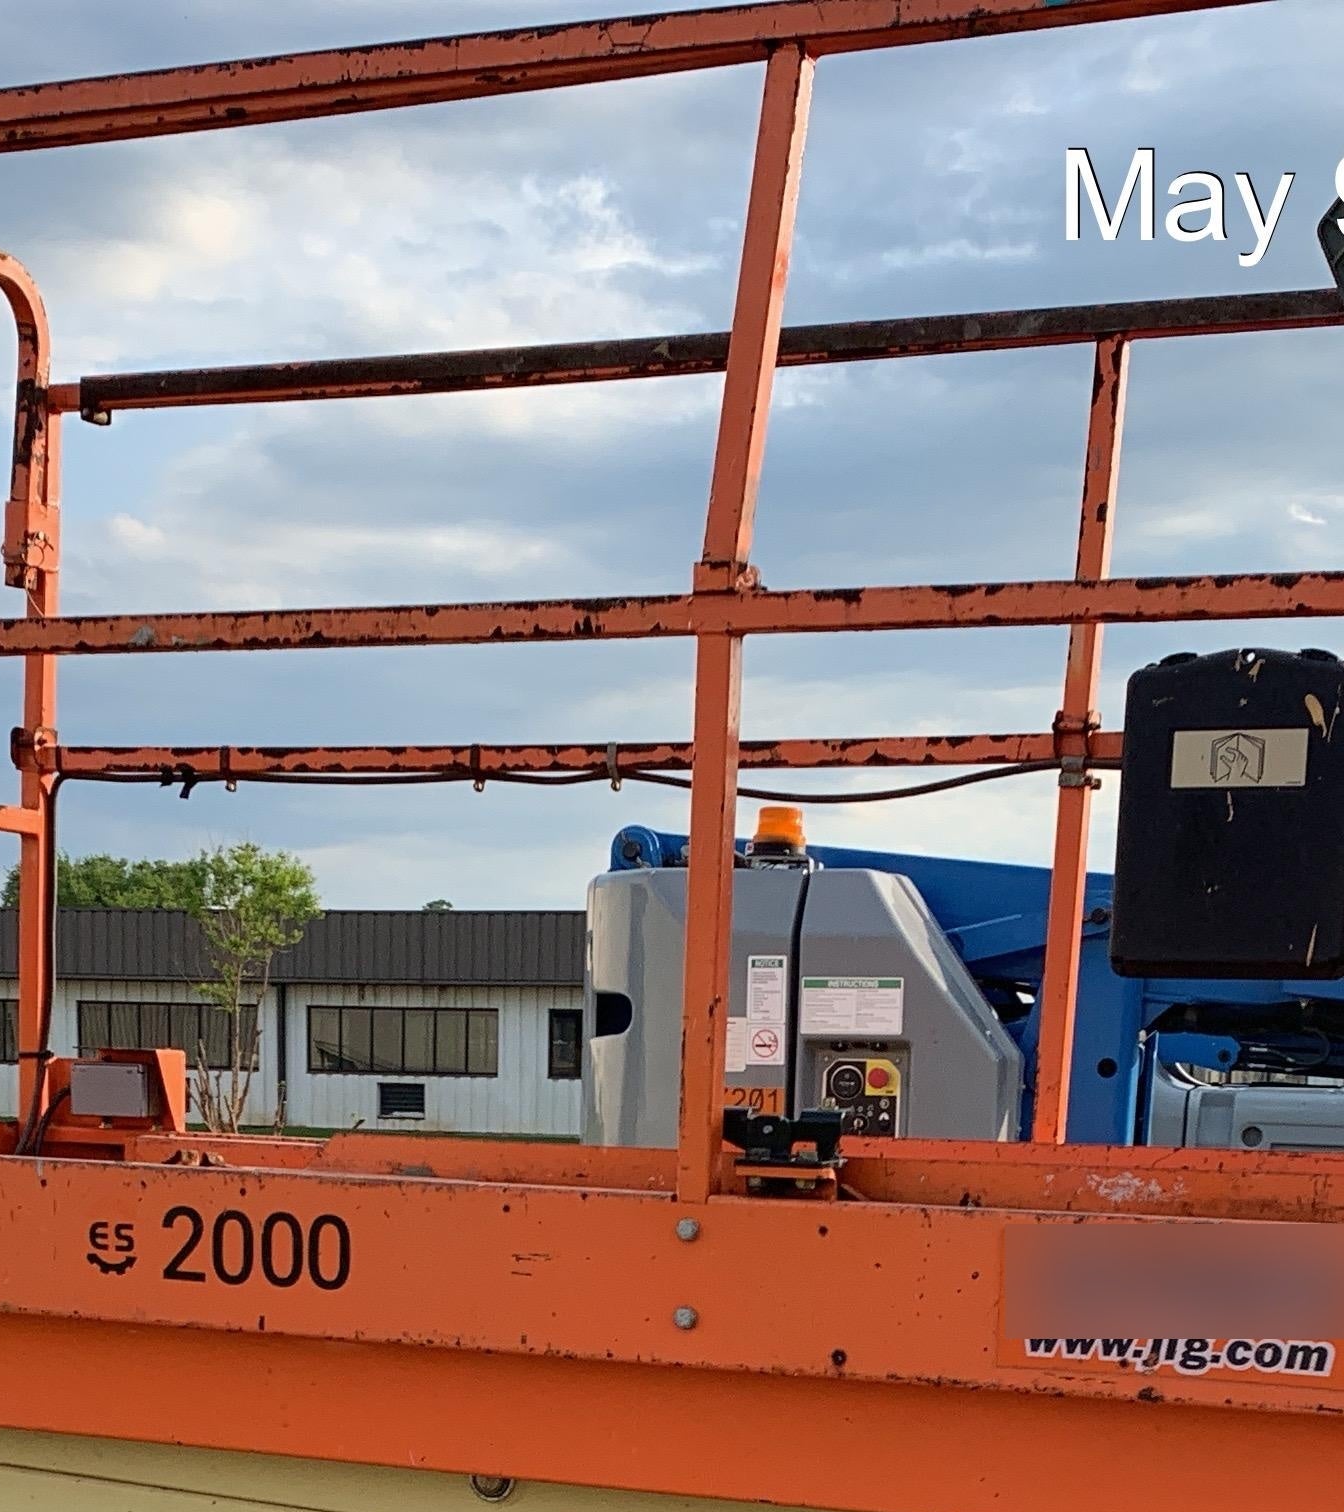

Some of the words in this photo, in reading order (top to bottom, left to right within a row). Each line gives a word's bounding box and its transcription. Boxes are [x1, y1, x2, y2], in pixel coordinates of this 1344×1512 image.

[724, 1086, 779, 1115] 201
[88, 1221, 135, 1252] ES
[161, 1205, 351, 1291] 2000
